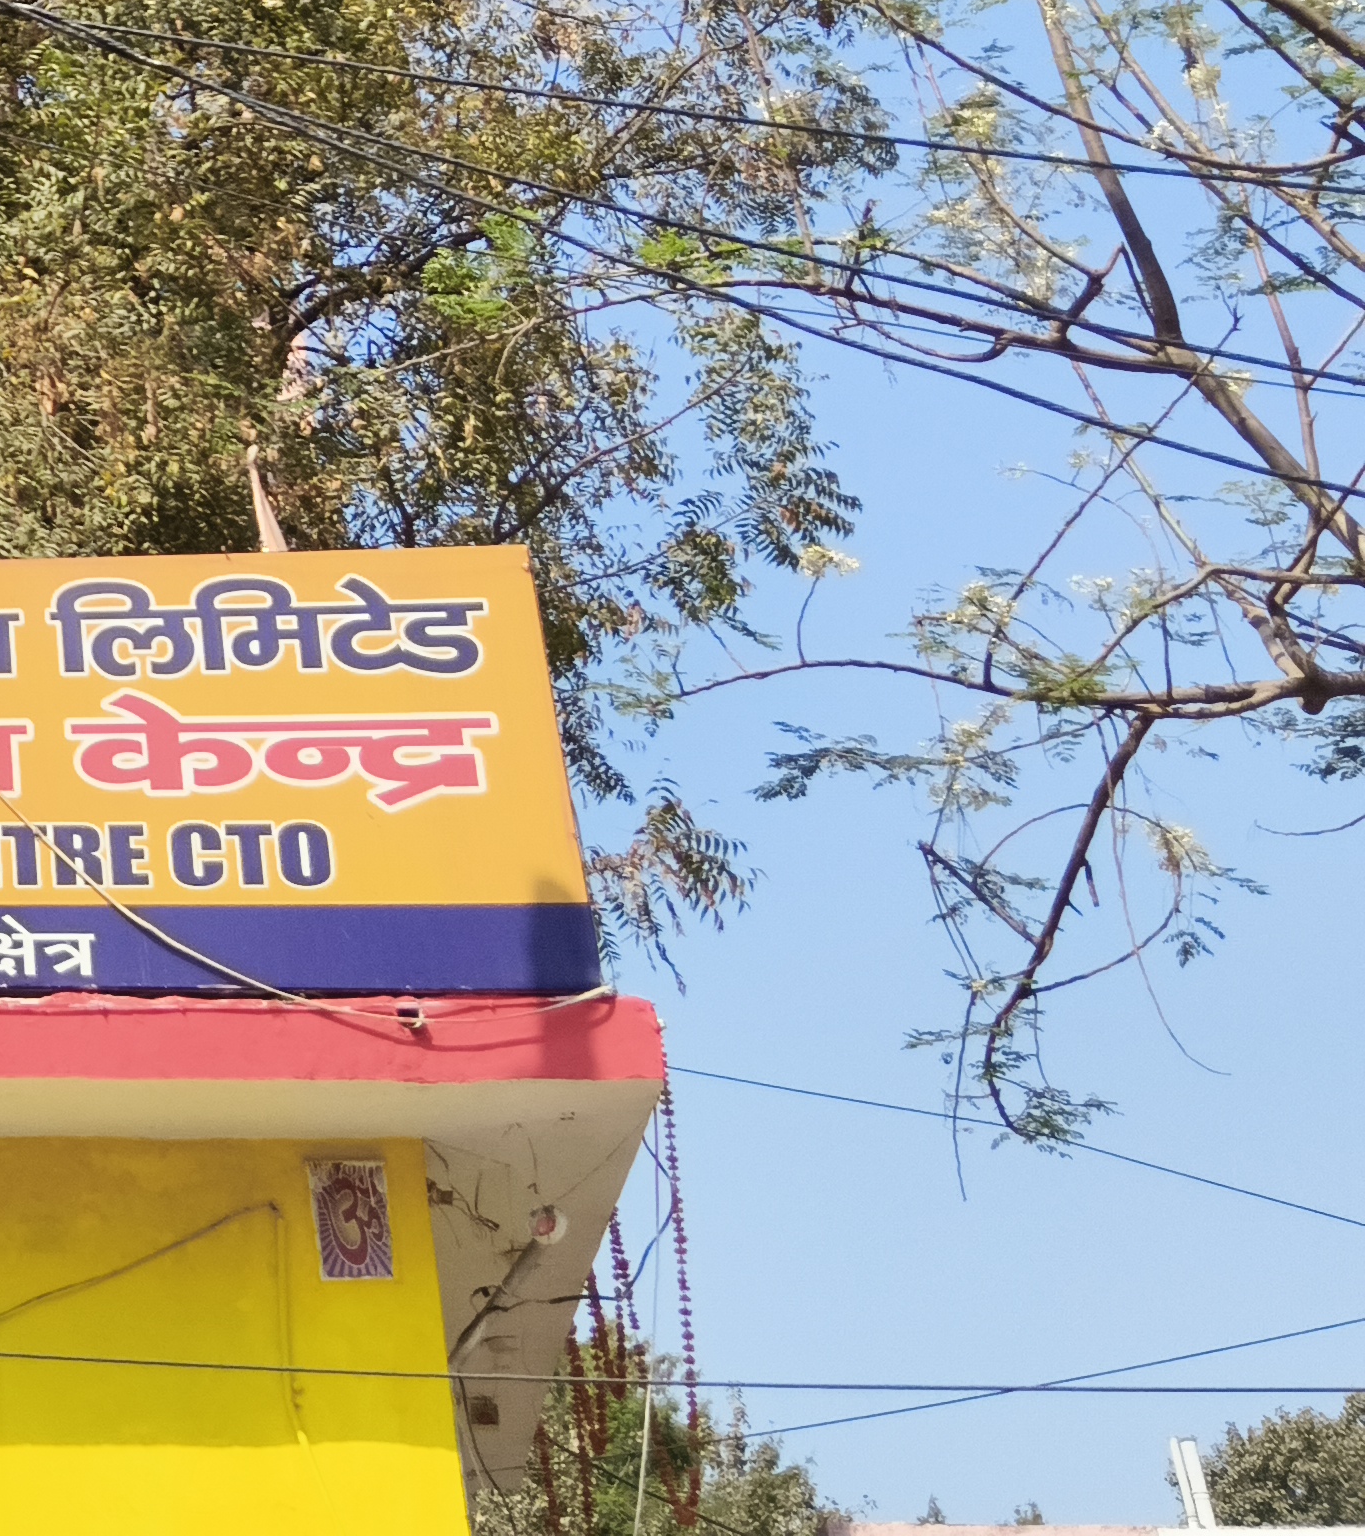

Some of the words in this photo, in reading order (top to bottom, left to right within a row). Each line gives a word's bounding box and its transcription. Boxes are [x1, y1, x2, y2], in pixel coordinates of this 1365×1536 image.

[49, 574, 487, 678] लिमिटेड
[64, 689, 498, 811] केन्द्र
[166, 821, 336, 889] CTO
